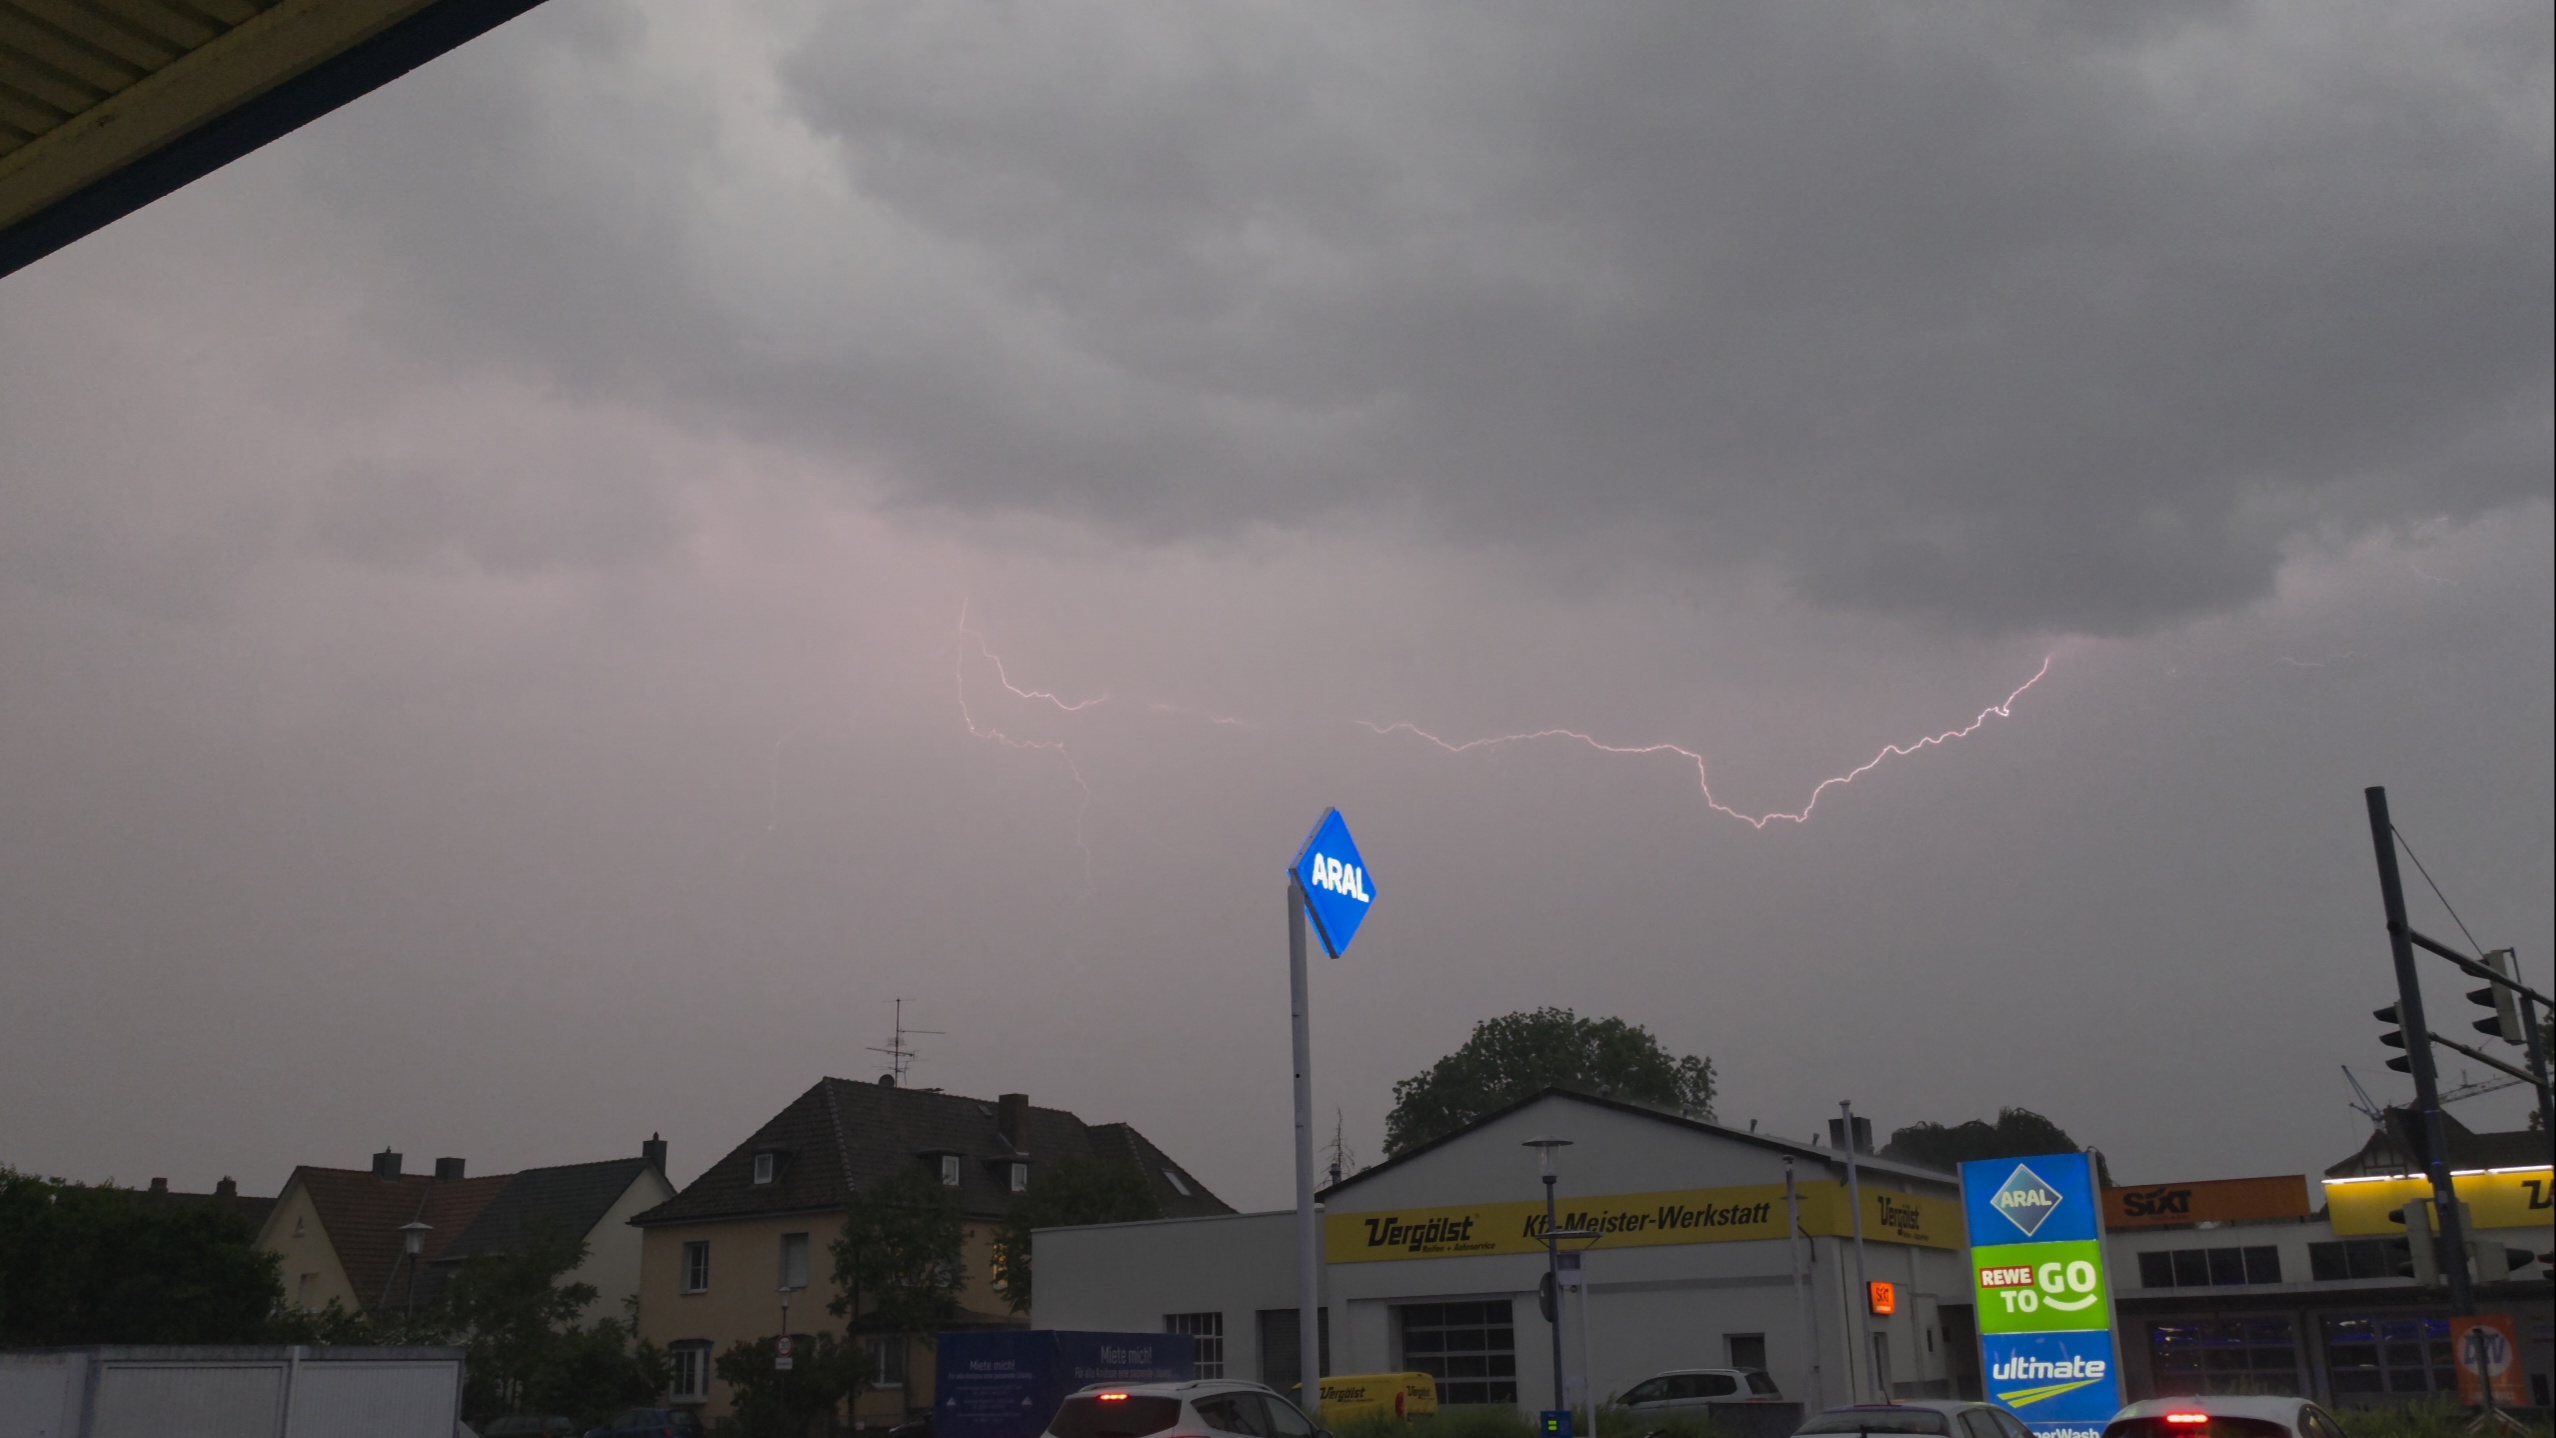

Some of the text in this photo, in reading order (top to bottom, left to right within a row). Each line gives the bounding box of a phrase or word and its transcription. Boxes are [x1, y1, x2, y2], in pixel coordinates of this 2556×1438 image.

[1312, 852, 1370, 903] ARAL
[2000, 1189, 2052, 1208] ARAL
[1364, 1215, 1474, 1252] Vergölst
[1523, 1202, 1771, 1237] Kf-Meister-Werkstatt
[1981, 1267, 2032, 1286] REWE
[2000, 1260, 2097, 1313] TO GO
[1100, 1345, 1127, 1365] Miete
[1993, 1355, 2106, 1380] ultimate
